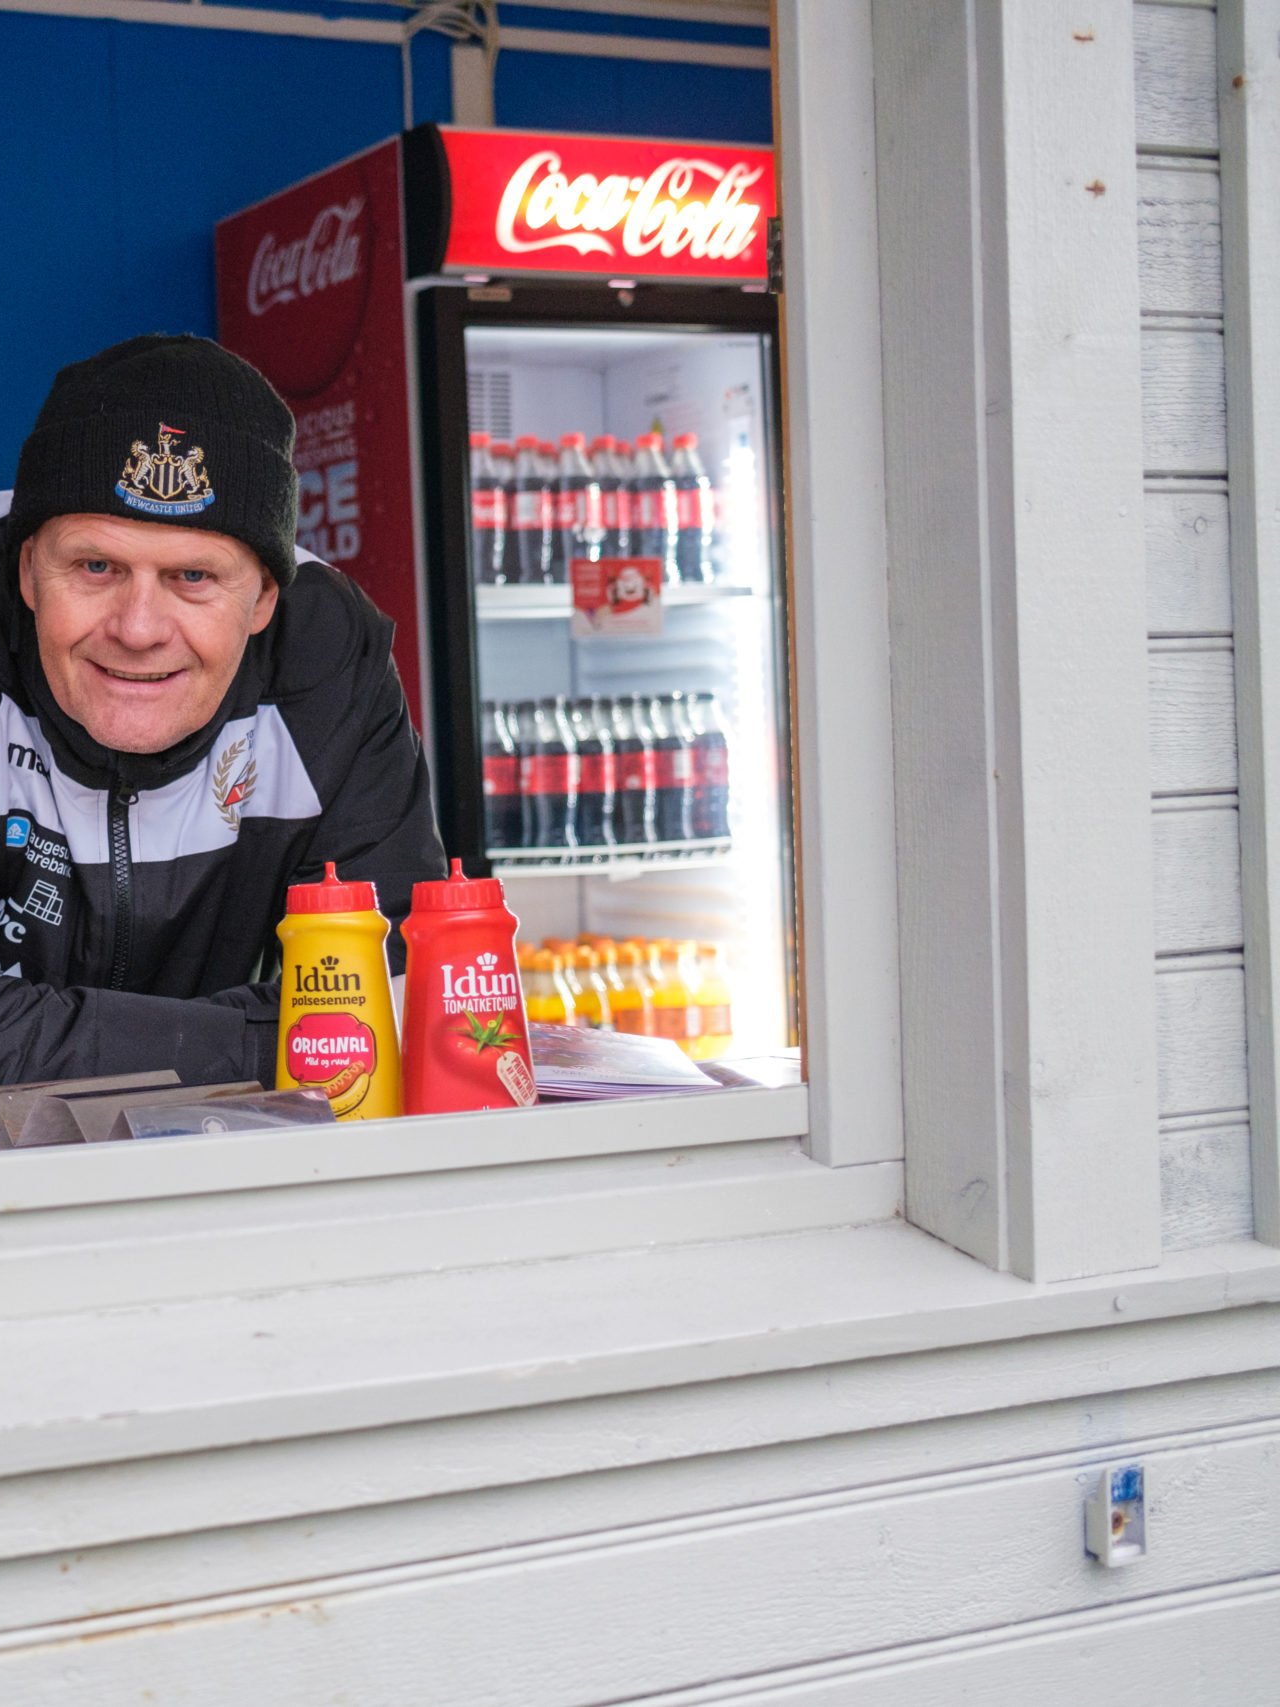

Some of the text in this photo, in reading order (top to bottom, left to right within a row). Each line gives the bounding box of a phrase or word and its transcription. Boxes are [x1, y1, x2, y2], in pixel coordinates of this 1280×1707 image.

[496, 150, 765, 260] Coca-Cola
[125, 495, 204, 513] NEWCASTLE UNITED
[294, 964, 361, 992] Idun
[440, 964, 517, 998] Idun
[443, 996, 518, 1015] TOMATKETCHUP
[292, 1036, 369, 1055] ORIGINAL
[304, 1056, 350, 1068] Mild og rund
